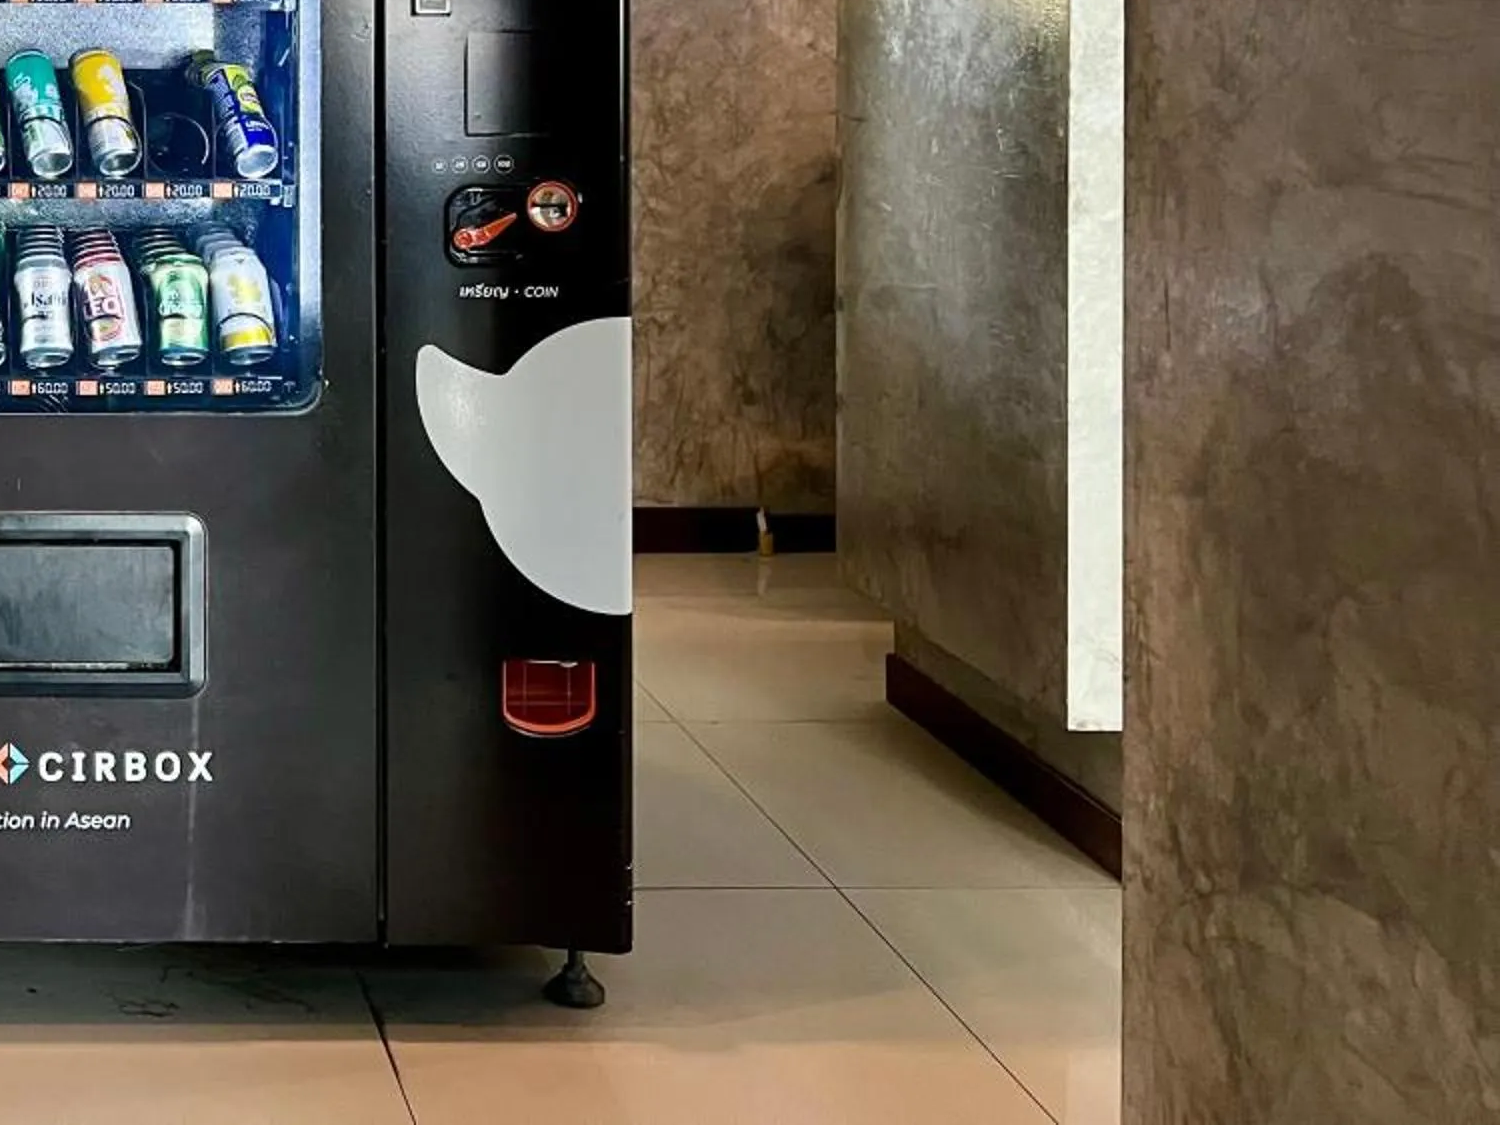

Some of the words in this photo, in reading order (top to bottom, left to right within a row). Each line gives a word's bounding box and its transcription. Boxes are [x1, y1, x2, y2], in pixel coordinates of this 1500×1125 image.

[459, 282, 510, 300] เหรียญ
[523, 285, 560, 299] COIN
[37, 751, 214, 783] CIRBOX
[41, 811, 61, 831] in
[65, 811, 132, 831] Asean
